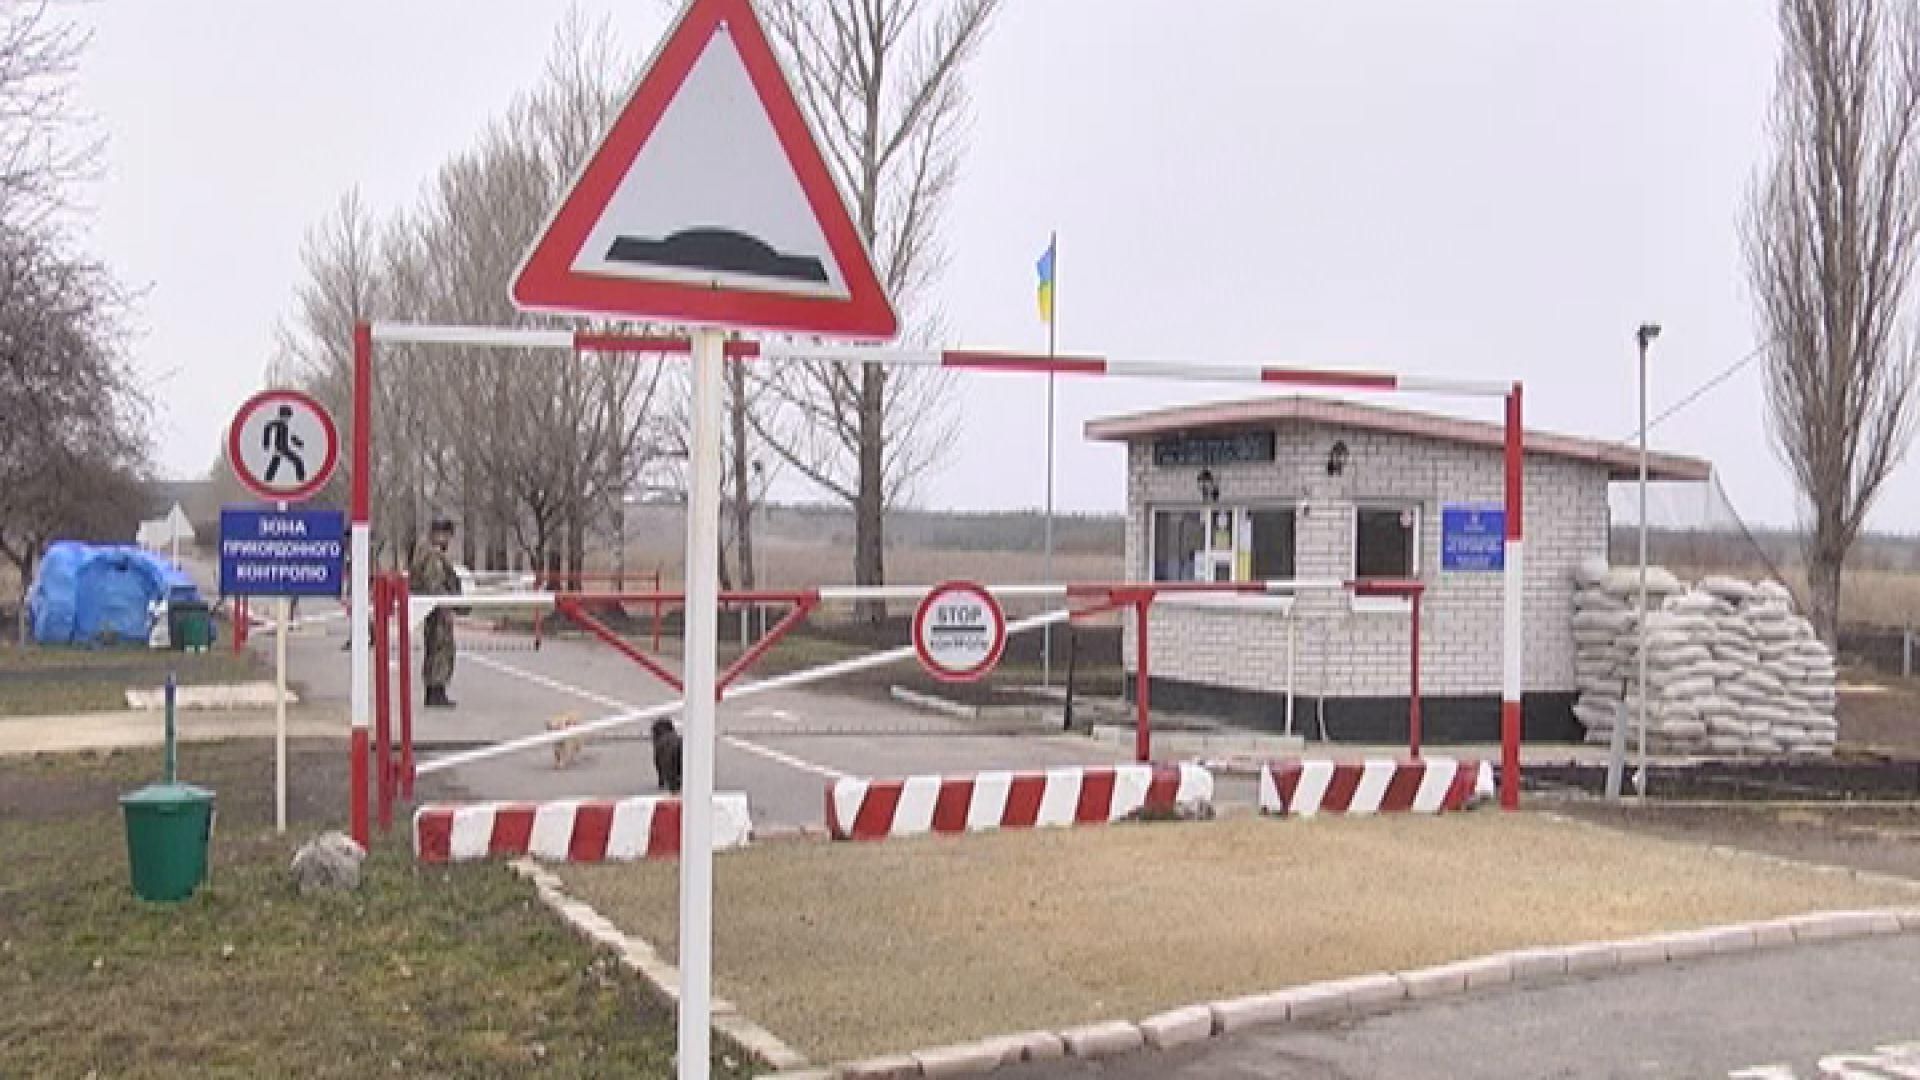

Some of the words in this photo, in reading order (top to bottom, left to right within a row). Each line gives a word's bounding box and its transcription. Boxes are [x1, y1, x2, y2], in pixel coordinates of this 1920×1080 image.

[260, 518, 307, 536] ЗОНА
[223, 539, 341, 557] ПРИКОРДОННОГО
[236, 564, 330, 582] КОНТРОЛЮ
[937, 605, 982, 623] STOP
